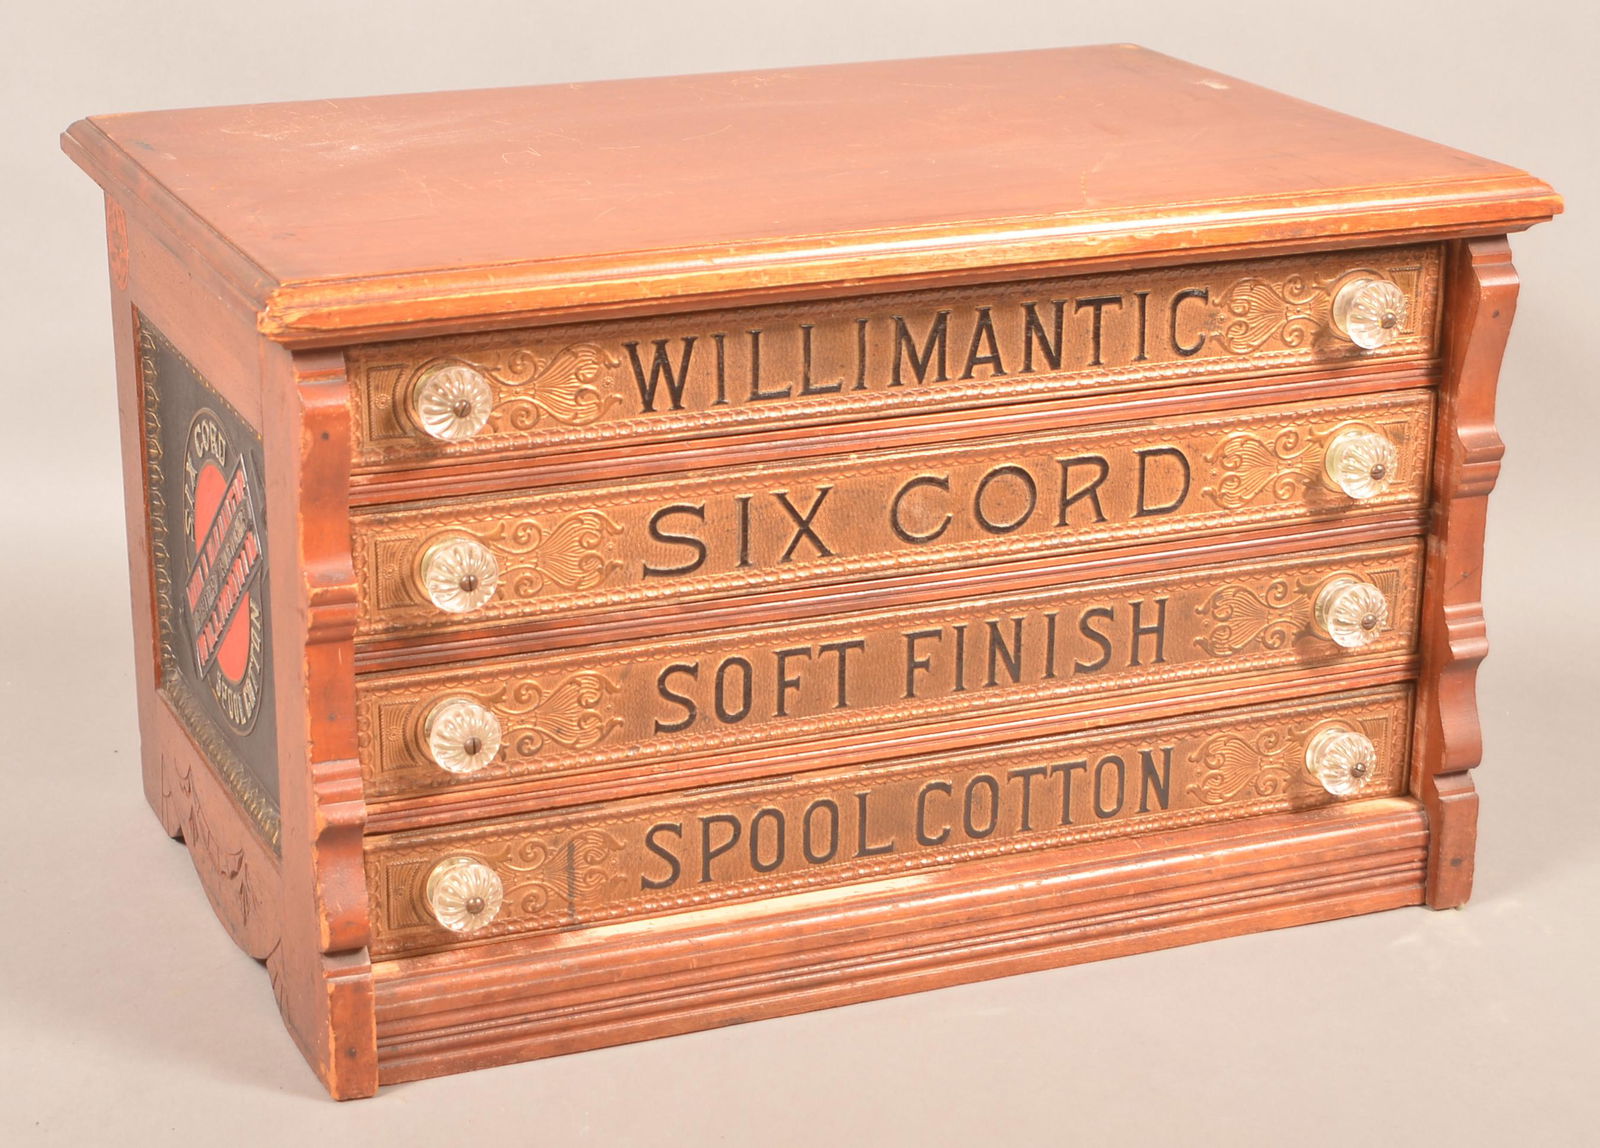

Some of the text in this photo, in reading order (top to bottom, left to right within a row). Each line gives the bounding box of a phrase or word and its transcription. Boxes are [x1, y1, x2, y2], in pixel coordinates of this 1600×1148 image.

[623, 287, 1210, 413] WILLIMANTIC
[184, 418, 226, 542] SIX CORD
[642, 446, 1191, 580] SIX CORD
[654, 598, 1169, 735] SOFT FINISH
[640, 747, 1174, 891] SPOOL COTTON
